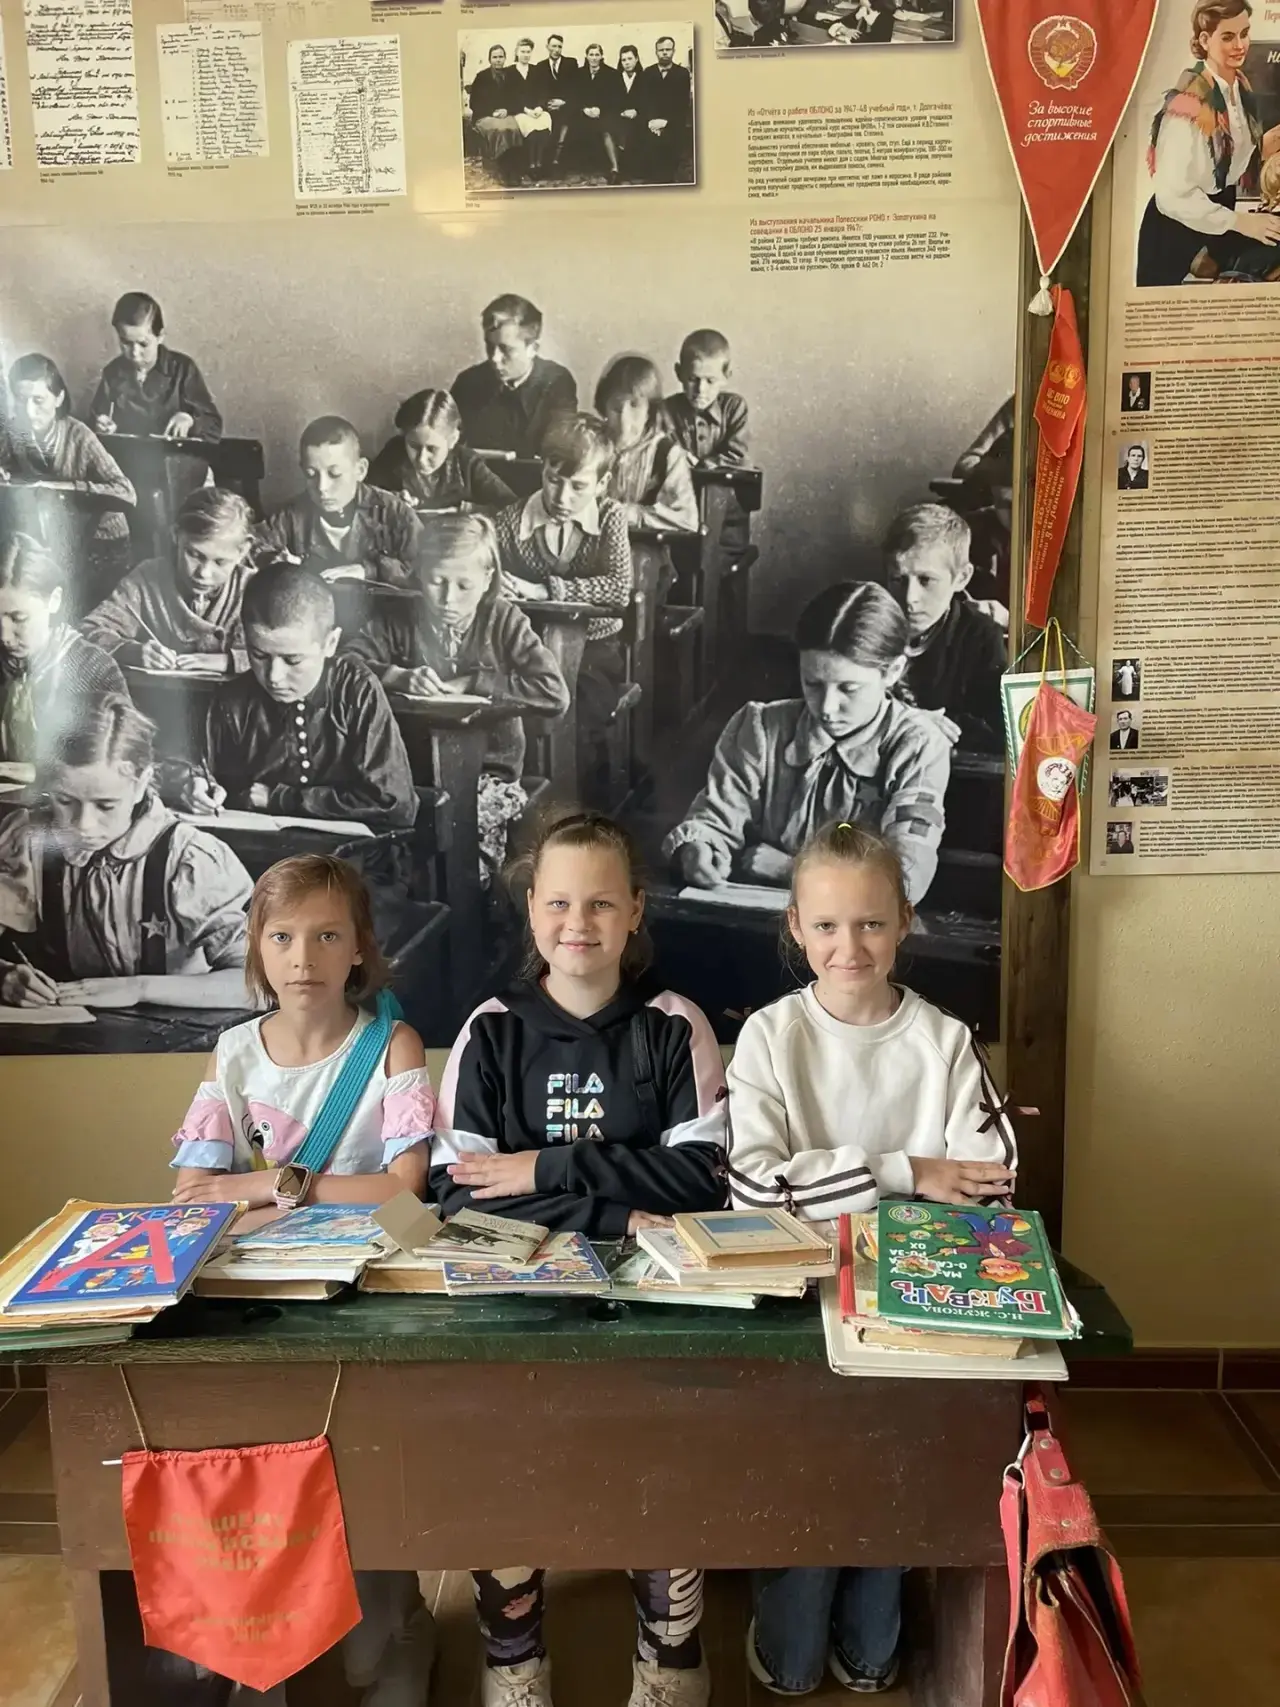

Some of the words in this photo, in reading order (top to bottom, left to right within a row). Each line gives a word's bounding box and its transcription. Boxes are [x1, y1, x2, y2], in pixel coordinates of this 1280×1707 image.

[787, 107, 808, 116] работе
[869, 104, 895, 113] учебный
[1028, 100, 1045, 115] За
[1048, 100, 1093, 116] высокие
[1027, 114, 1093, 131] спортивные
[1020, 129, 1098, 147] достижения
[759, 218, 797, 227] выступления
[823, 226, 844, 234] января
[1054, 392, 1070, 405] ВПО
[547, 1072, 605, 1094] FILA
[546, 1098, 605, 1119] FILA
[96, 1207, 220, 1223] БУКВАРЬ
[450, 1270, 598, 1281] БУКВАРЬ
[890, 1280, 1051, 1315] БУКВАРЬ
[921, 1305, 990, 1318] ЖУКОВА
